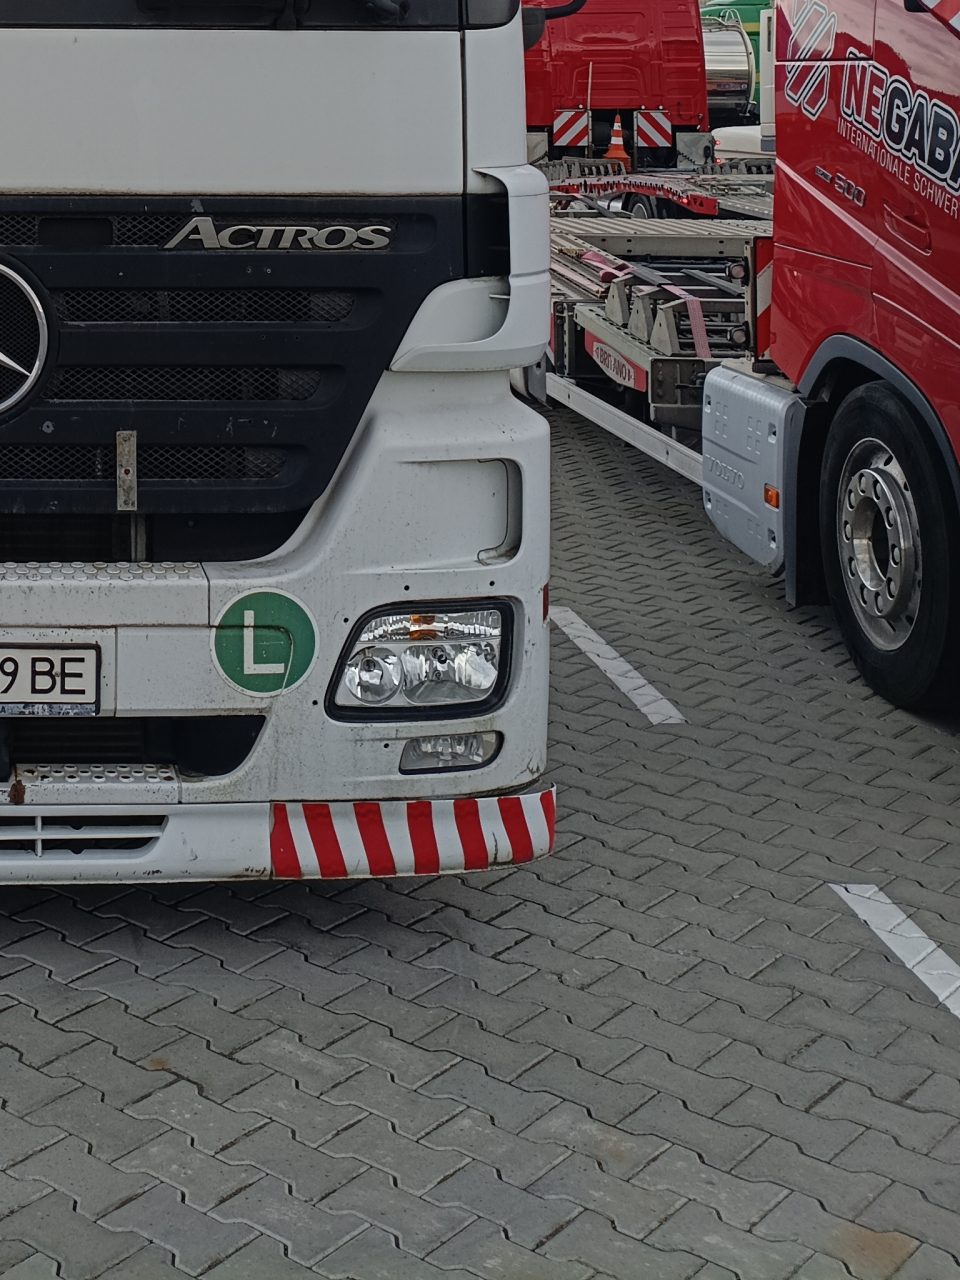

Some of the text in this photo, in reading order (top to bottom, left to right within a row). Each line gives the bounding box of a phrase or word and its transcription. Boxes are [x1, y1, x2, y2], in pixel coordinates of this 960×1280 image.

[837, 117, 960, 219] INTERNATIONALE SCHWER
[243, 609, 284, 675] L
[30, 656, 86, 695] BE
